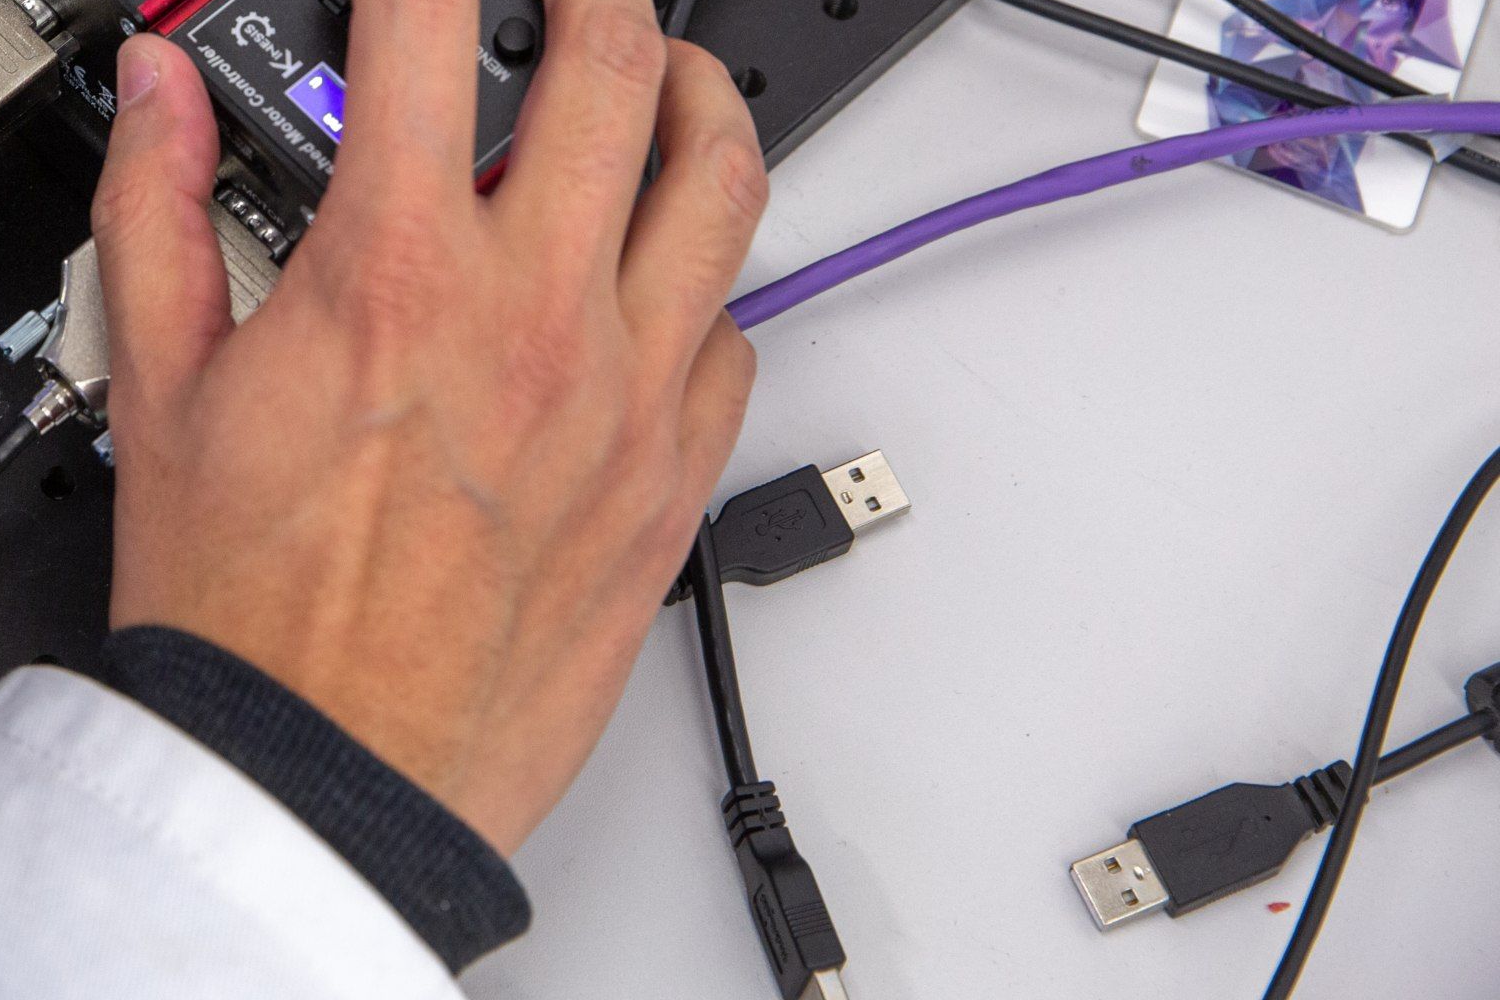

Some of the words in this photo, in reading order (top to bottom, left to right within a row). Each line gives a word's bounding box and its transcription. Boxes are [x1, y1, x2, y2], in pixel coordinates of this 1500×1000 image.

[197, 44, 265, 107] Controller
[261, 106, 306, 146] Motor
[299, 142, 335, 175] shed
